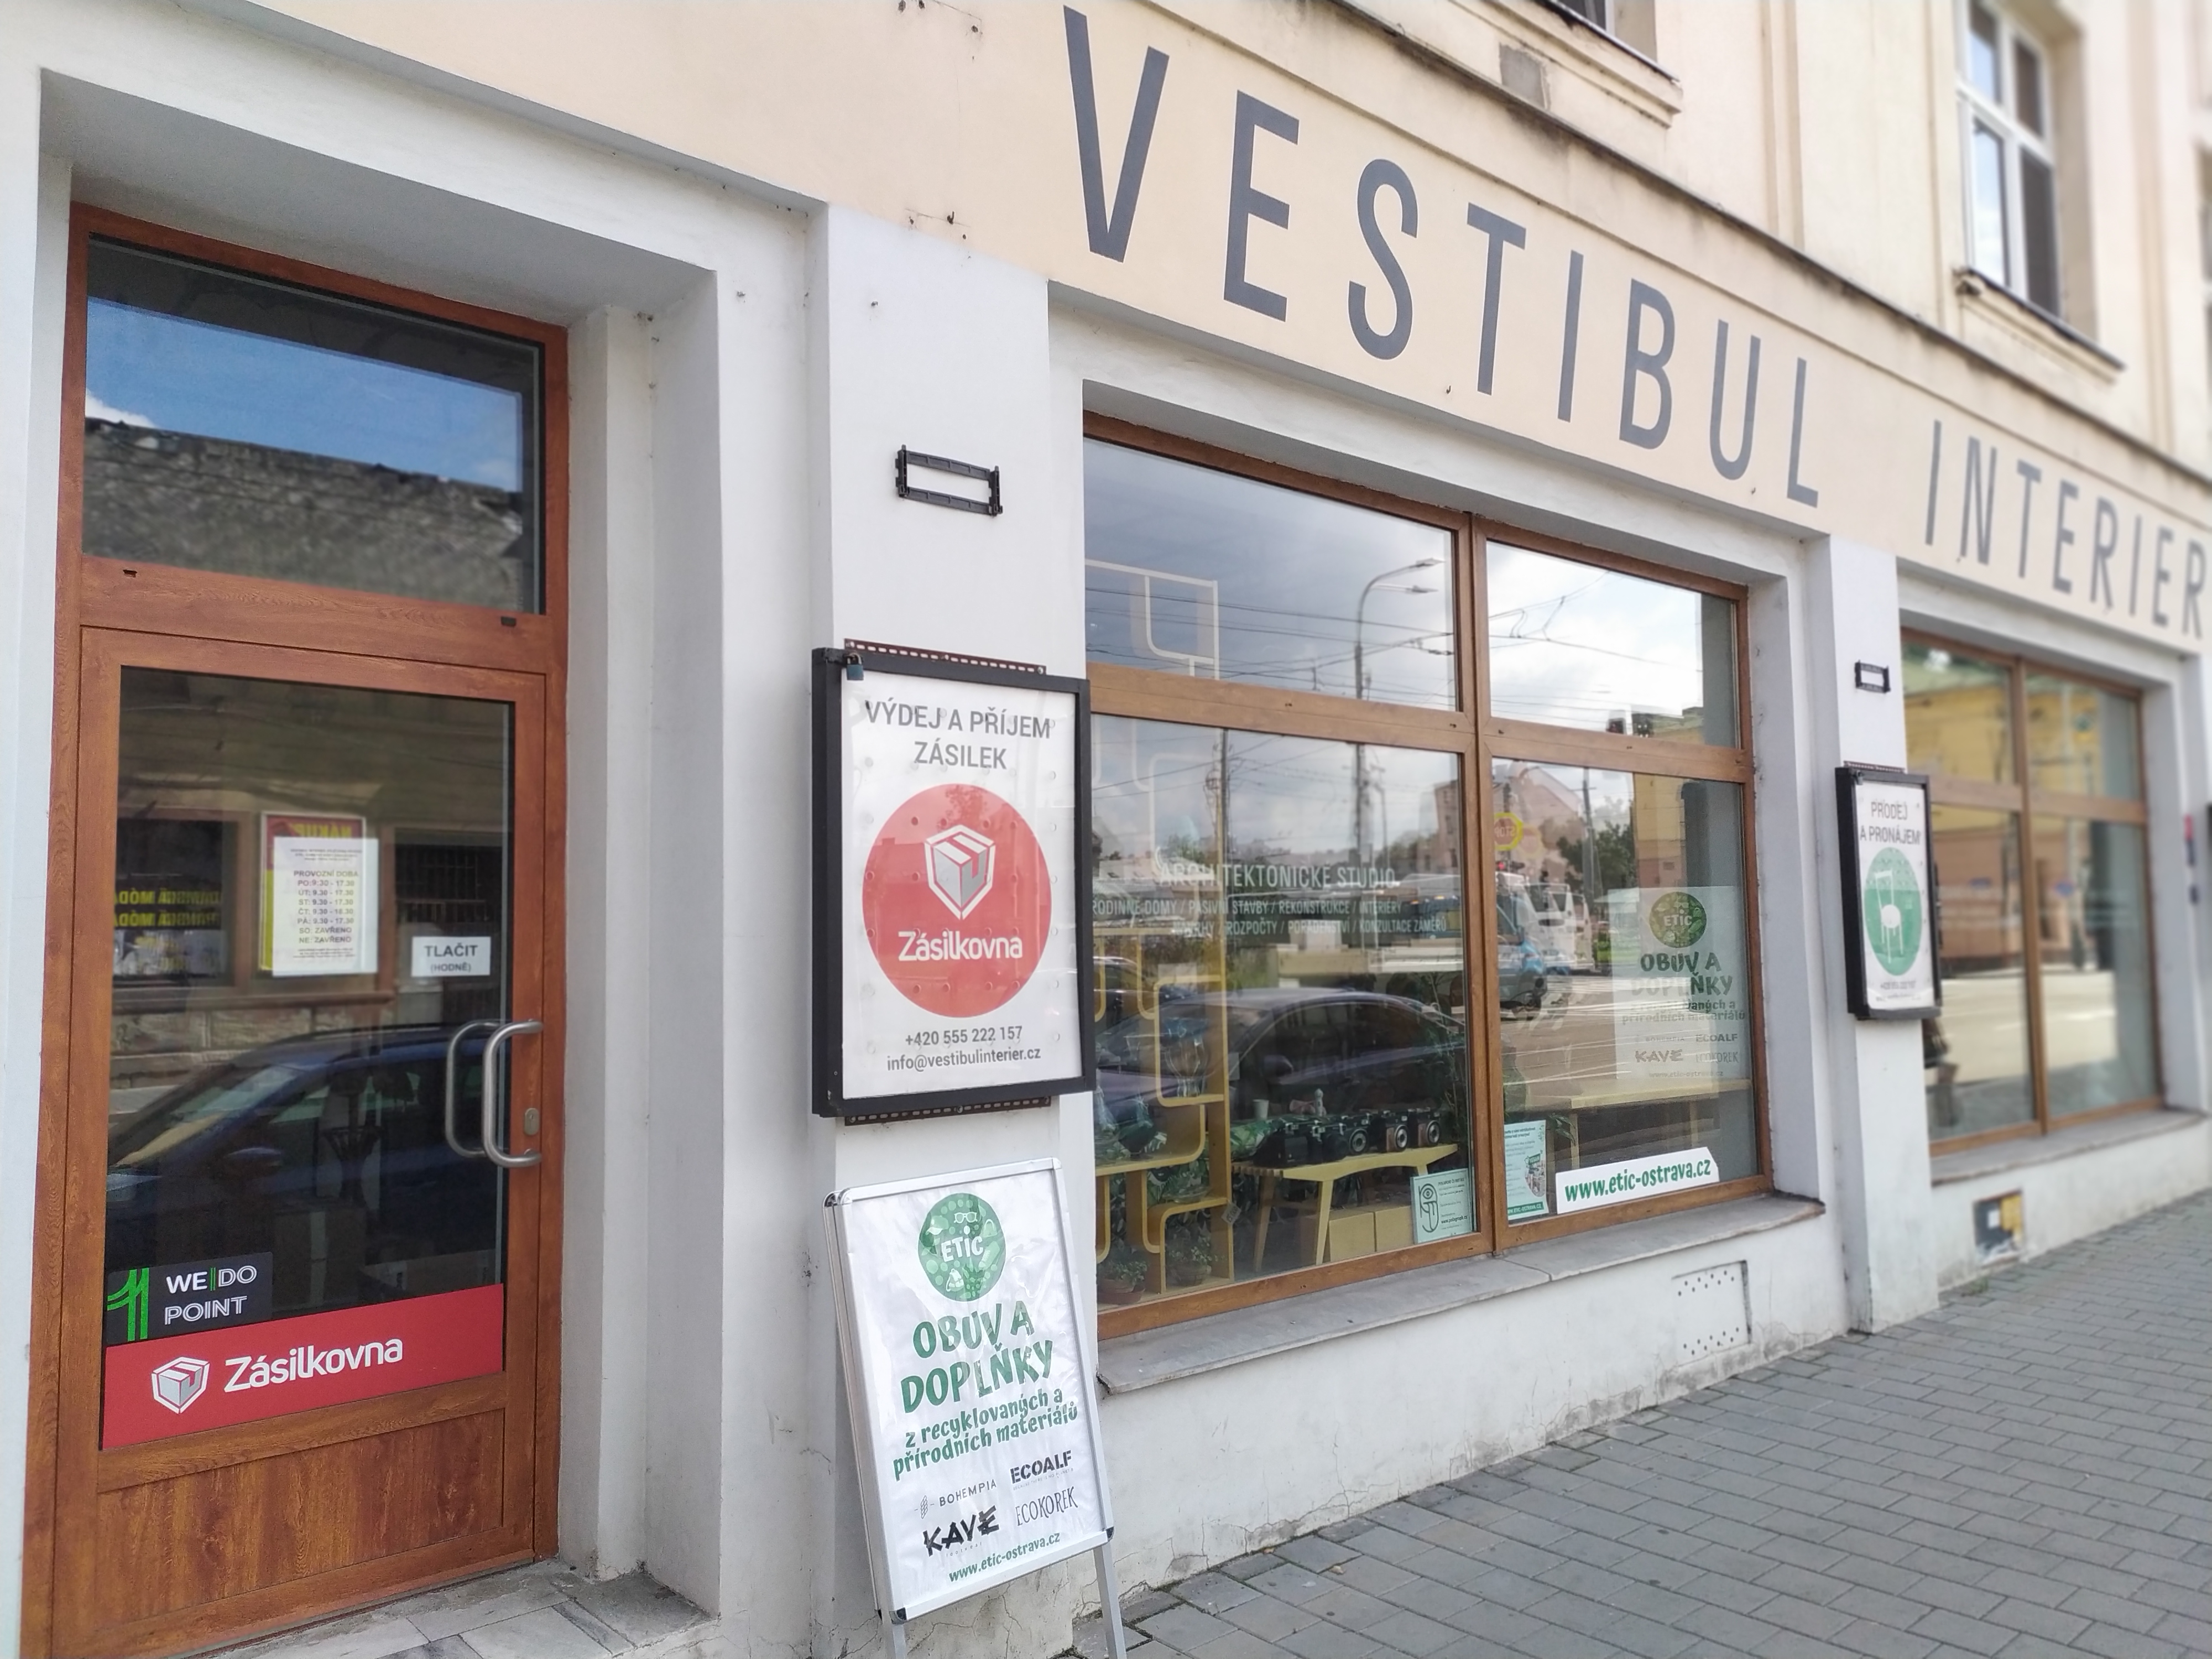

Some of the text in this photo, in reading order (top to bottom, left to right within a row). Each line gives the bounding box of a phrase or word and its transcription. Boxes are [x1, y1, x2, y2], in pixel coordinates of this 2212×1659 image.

[1063, 4, 2206, 640] VESTIBUL INTERIER
[865, 697, 1050, 739] VÝDEJ A PŘÍJEM
[914, 738, 1007, 770] ZÁSILEK
[1871, 800, 1908, 821] PRODEJ
[1860, 825, 1921, 846] A PRONÁJEM
[1337, 867, 1395, 889] STUDIO
[1145, 900, 1177, 915] DOMY
[1233, 900, 1269, 915] STAVBY
[1279, 901, 1350, 914] REKONSTRUKCE
[1226, 918, 1277, 935] ROZPOČTY
[1360, 920, 1411, 933] KONZULTACE
[424, 942, 478, 957] TLAČIT
[898, 930, 1022, 961] Zásilkovna
[430, 962, 471, 973] (HODNĚ)
[1640, 952, 1721, 973] OBUV A
[905, 1026, 1022, 1046] +420 555 222 157
[1696, 1034, 1738, 1042] ECOALF
[887, 1047, 1041, 1073] info@vestibulinterier.cz
[1565, 1159, 1711, 1202] www.etic-ostrava.cz
[164, 1296, 247, 1325] POINT
[912, 1300, 1035, 1359] OBUV A
[224, 1338, 403, 1393] Zásilkovna
[900, 1339, 1053, 1413] DOPLŇKY
[905, 1388, 1063, 1448] z recyklovaných a
[893, 1401, 1078, 1482] přírodních materiálů
[1010, 1450, 1071, 1484] ECOALF
[939, 1479, 997, 1507] BOHEMPIA
[1015, 1486, 1078, 1526] ECOKOREK
[922, 1505, 999, 1557] KAVE
[949, 1532, 1060, 1582] www.etic-ostrava.cz
